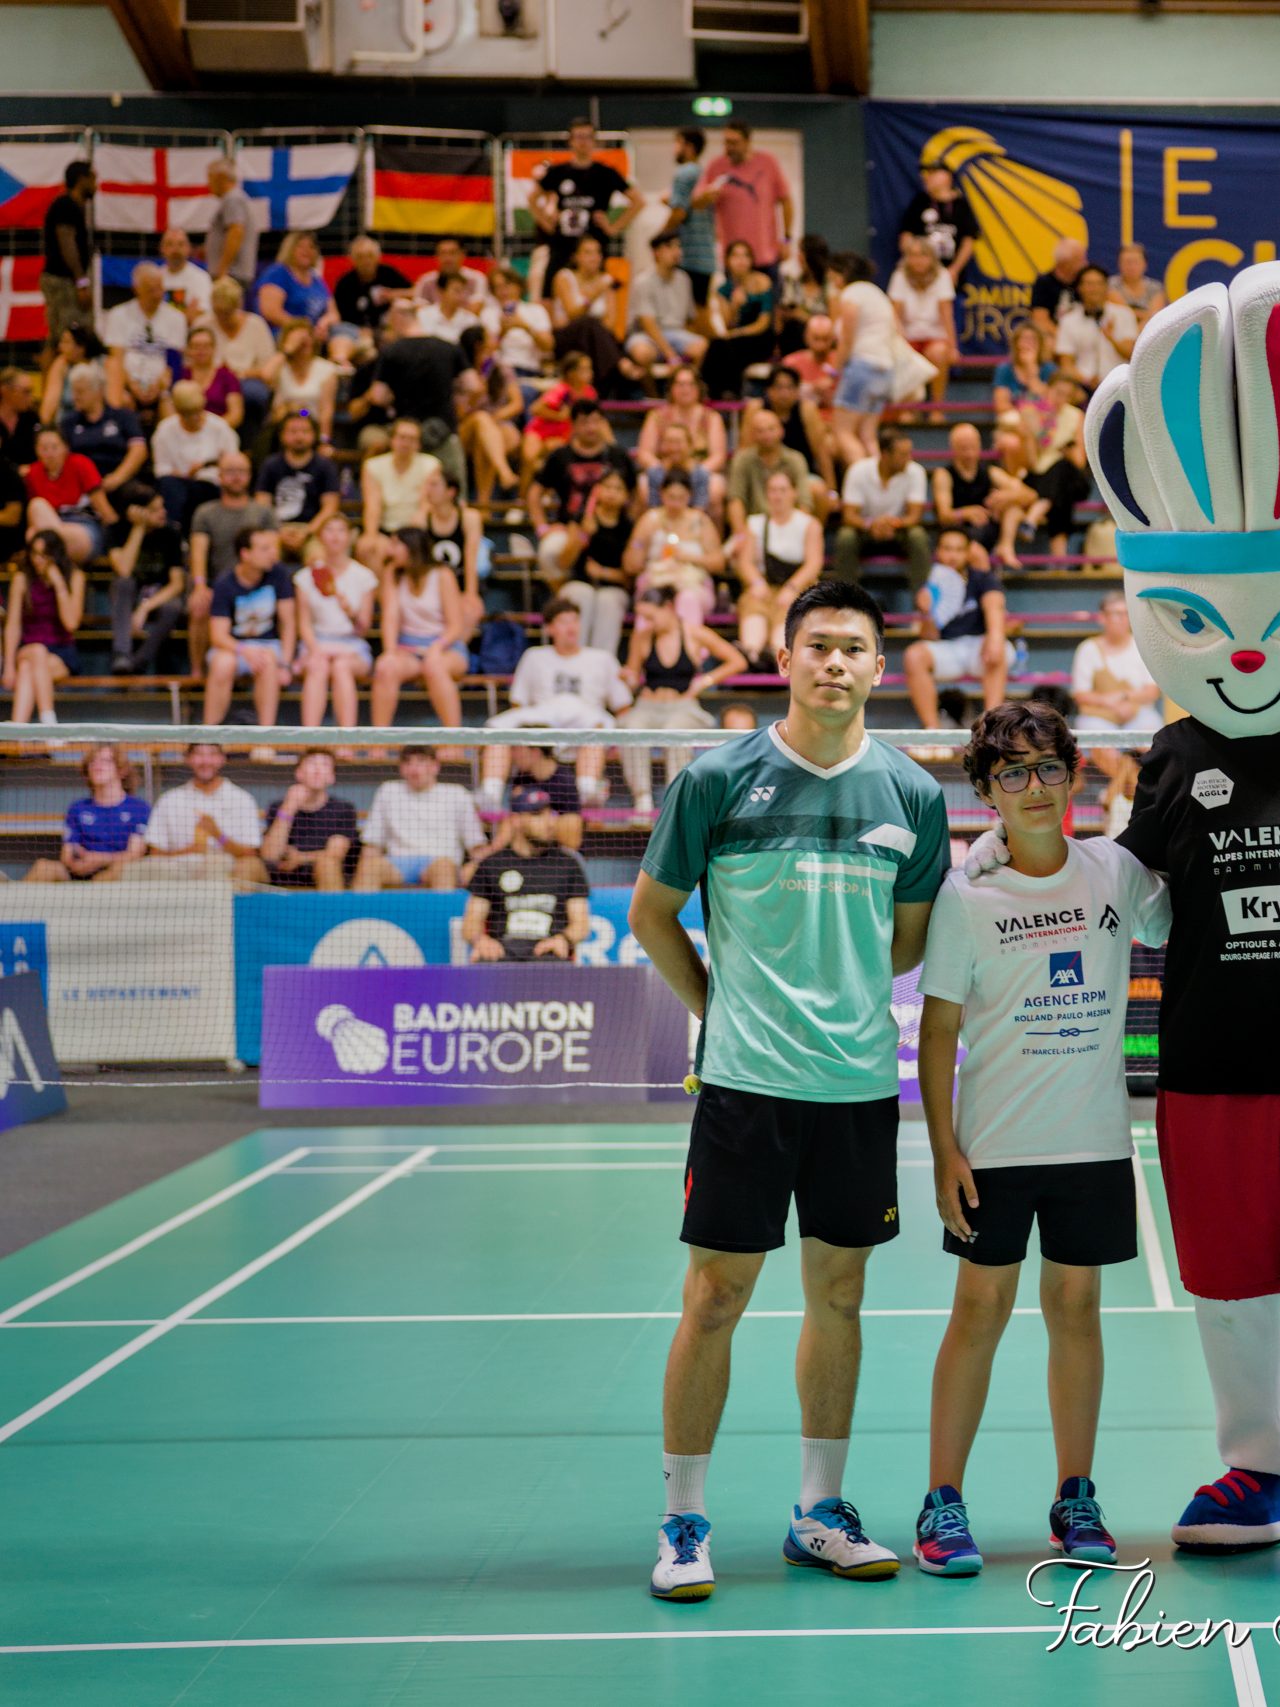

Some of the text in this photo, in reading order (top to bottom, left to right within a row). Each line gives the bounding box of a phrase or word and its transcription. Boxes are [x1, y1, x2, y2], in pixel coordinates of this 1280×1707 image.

[1212, 851, 1243, 864] ALPES
[995, 907, 1086, 934] VALENCE
[999, 924, 1088, 945] ALPES INTERNATIONAL
[1225, 940, 1268, 950] OPTIQUE
[1050, 968, 1079, 985] AXA
[1023, 989, 1107, 1008] AGENCE RPM
[393, 1001, 595, 1032] BADMINTON
[393, 1031, 593, 1074] EUROPE
